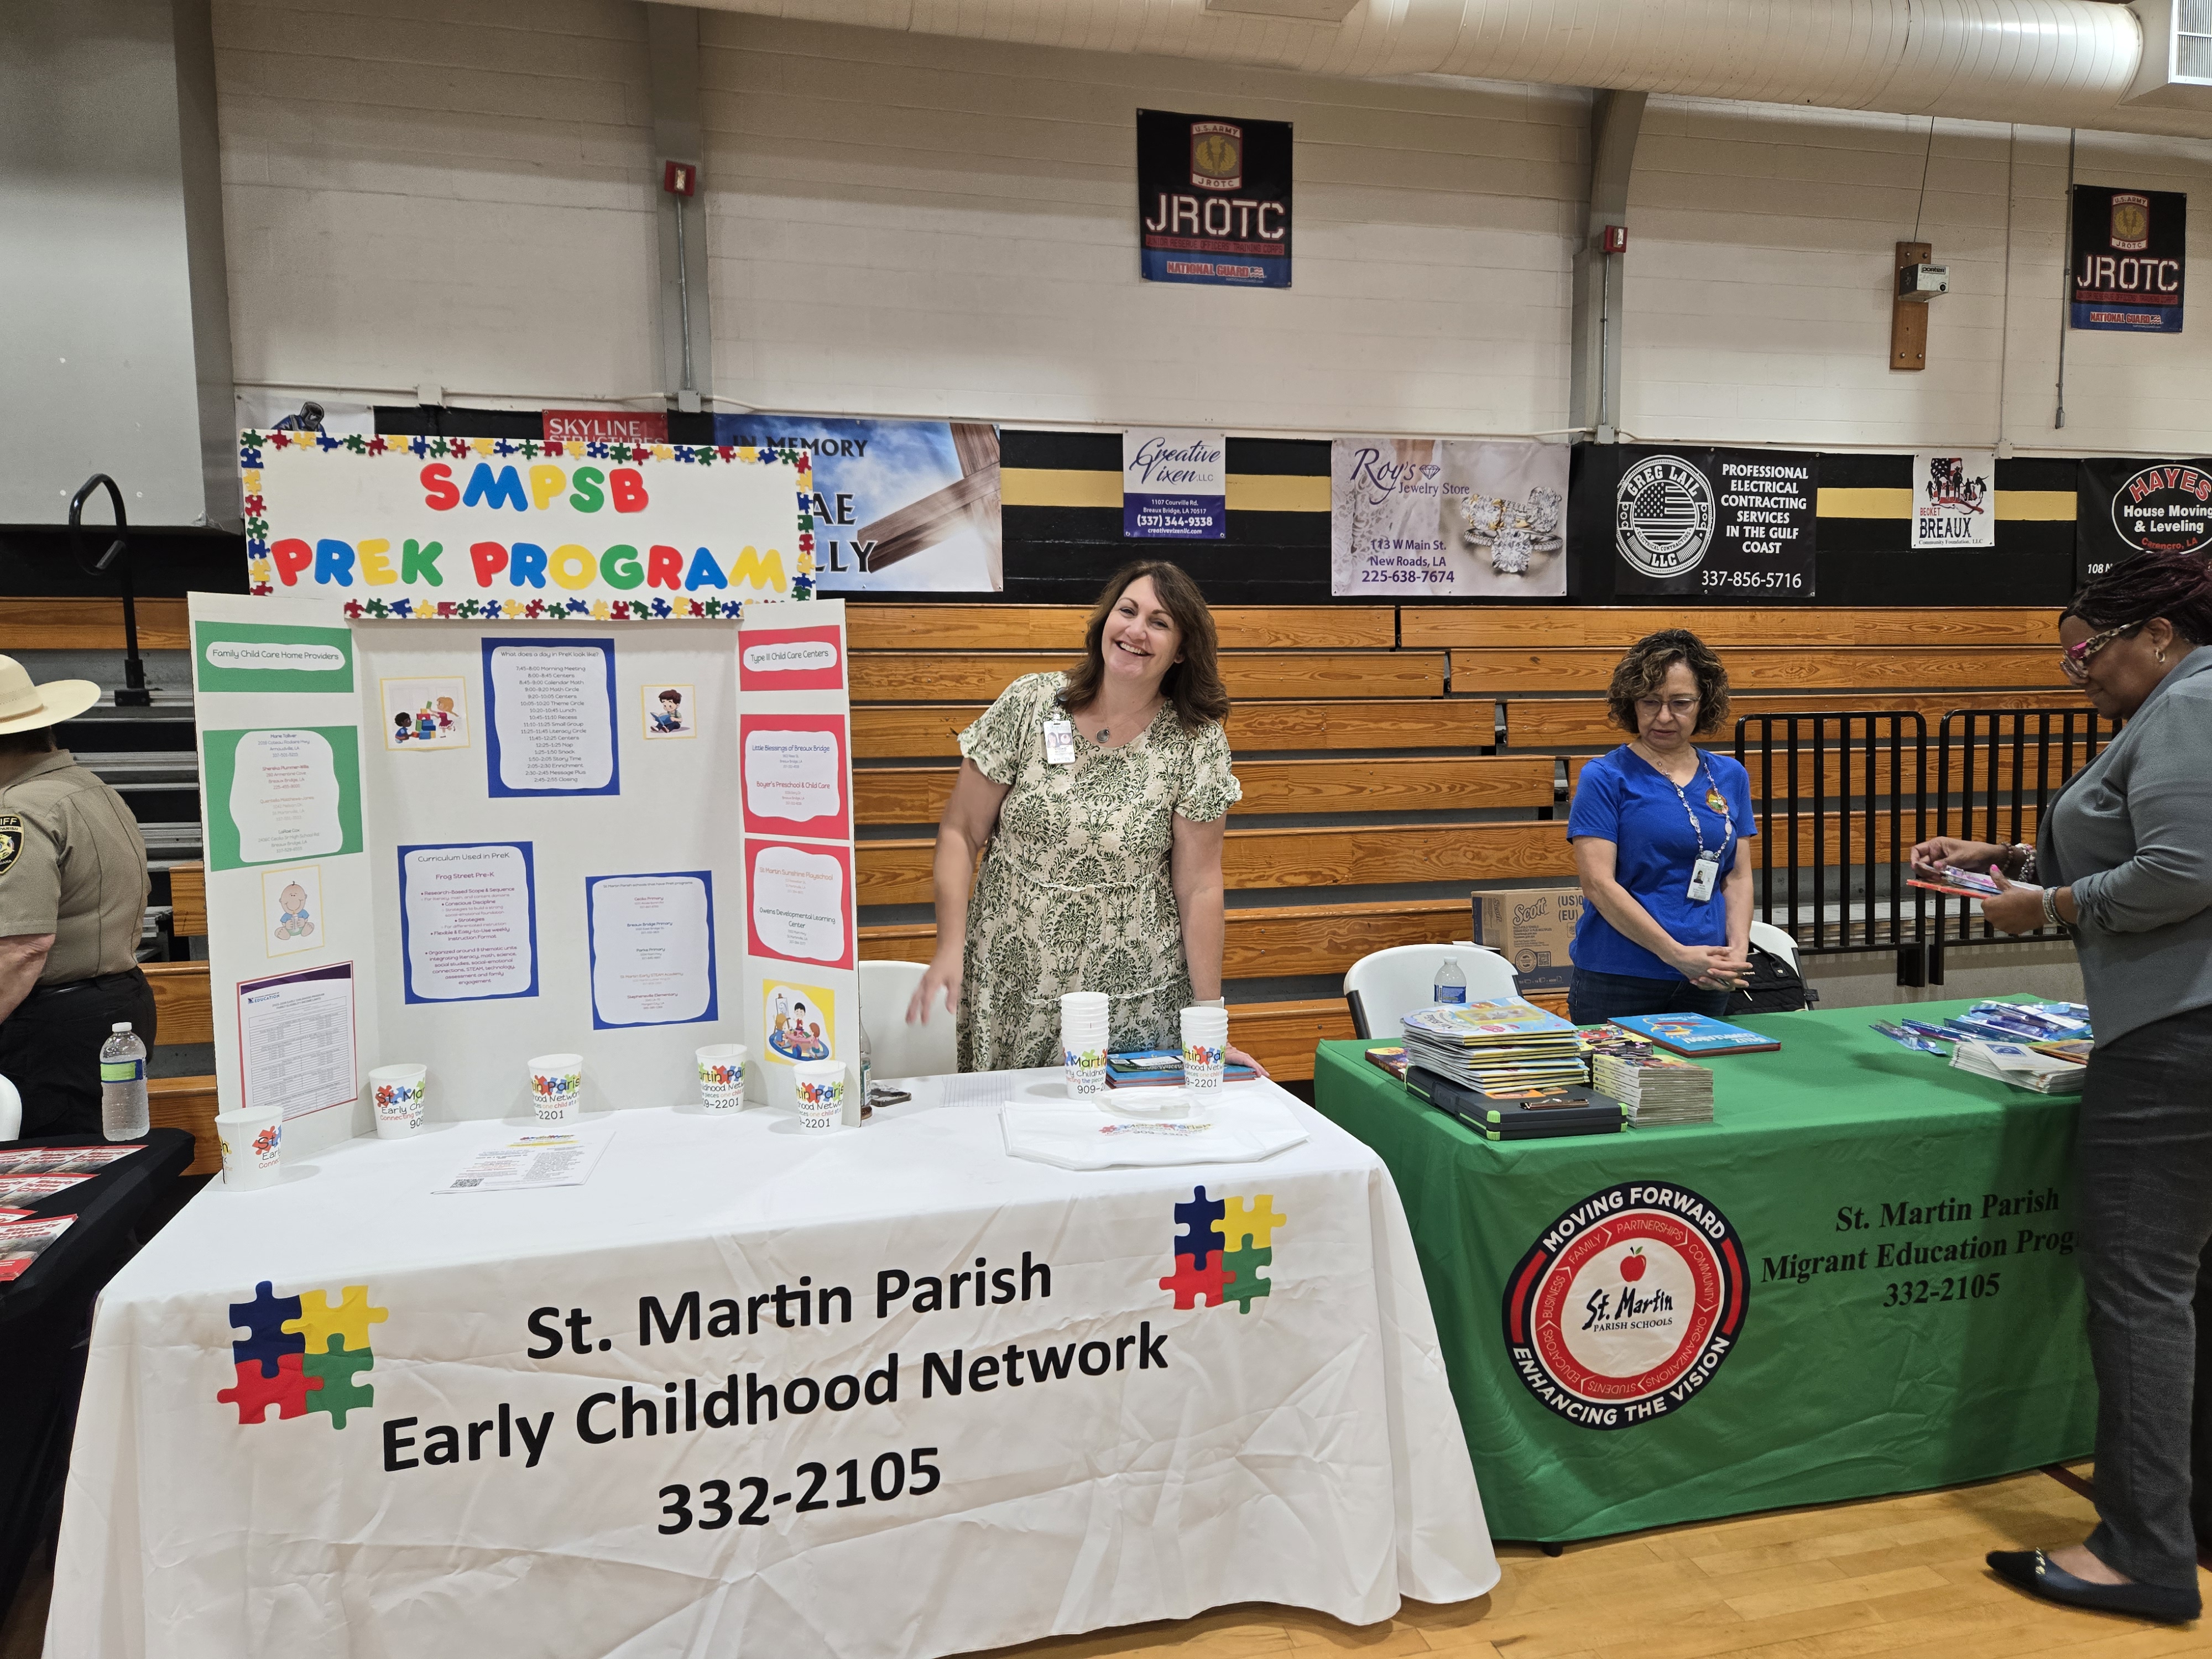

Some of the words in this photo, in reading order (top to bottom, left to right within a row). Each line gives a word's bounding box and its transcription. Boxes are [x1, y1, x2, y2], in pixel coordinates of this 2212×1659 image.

[1212, 125, 1238, 135] ARMY
[1198, 178, 1234, 187] JROTC
[1145, 193, 1285, 240] JROTC
[1167, 261, 1215, 275] NATIONAL
[1217, 264, 1250, 278] GUARD
[2077, 254, 2179, 291] JROTC
[2090, 312, 2125, 323] NATIONAL
[2126, 314, 2151, 324] GUARD
[549, 419, 639, 435] SKYLINE
[766, 435, 868, 457] MEMORY
[1136, 437, 1220, 466] Creative
[1350, 448, 1415, 505] Roy's
[1722, 464, 1809, 479] PROFESSIONAL
[420, 462, 649, 513] SMPSB
[1627, 466, 1663, 497] GREG
[1669, 466, 1699, 497] LAIL
[1730, 480, 1799, 494] ELECTRICAL
[2128, 468, 2211, 503] HAYES
[1398, 482, 1438, 499] Jewelry
[1443, 483, 1470, 494] Store
[1721, 495, 1807, 509] CONTRACTING
[1737, 511, 1790, 524] SERVICES
[2124, 505, 2164, 517] House
[1137, 514, 1162, 526] (337)
[1165, 517, 1213, 526] 344-9338
[1919, 518, 1971, 538] BREAUX
[2135, 520, 2146, 532] &
[2150, 520, 2204, 534] Leveling
[1636, 531, 1660, 551] ELECTRICAL
[1661, 531, 1691, 551] CONTRACTORS
[1726, 526, 1739, 537] IN
[1743, 526, 1766, 538] THE
[1770, 527, 1799, 539] GULF
[1371, 540, 1391, 550] 113
[1392, 540, 1404, 550] W
[1405, 540, 1431, 550] Main
[1433, 540, 1447, 550] St.
[1743, 541, 1782, 554] COAST
[2186, 537, 2198, 547] LA
[272, 538, 443, 588] PREK
[470, 544, 787, 593] PROGRAM
[1370, 556, 1395, 566] New
[1396, 556, 1431, 568] Roads,
[1433, 556, 1446, 566] LA
[1651, 553, 1677, 567] LLC
[2088, 564, 2104, 573] 108
[1361, 570, 1454, 582] 225-638-7674
[1702, 571, 1802, 588] 337-856-5716
[213, 649, 239, 659] Family
[751, 653, 765, 664] Type
[771, 652, 786, 660] Child
[803, 650, 829, 659] Centers
[1512, 897, 1547, 926] Scott
[1558, 910, 1578, 922] (EU)
[254, 994, 280, 1003] EDUCATION
[378, 1092, 397, 1104] St.
[382, 1106, 406, 1114] Early
[1836, 1206, 1870, 1232] St.
[1879, 1197, 1972, 1228] Martin
[1980, 1187, 2059, 1219] Parish
[1542, 1191, 1624, 1253] MOVING
[1630, 1187, 1726, 1239] FORWARD
[1568, 1234, 1601, 1264] FAMILY
[1616, 1220, 1683, 1241] PARTNERSHIPS
[1688, 1244, 1714, 1302] COMMUNITY
[1761, 1248, 1869, 1285] Migrant
[1875, 1237, 2007, 1269] Education
[1542, 1276, 1566, 1317] BUSINESS
[1883, 1272, 2001, 1308] 332-2105
[527, 1303, 612, 1360] St.
[637, 1274, 854, 1347] Martin
[875, 1250, 1051, 1319] Parish
[1582, 1288, 1610, 1330] St.
[1615, 1286, 1673, 1319] Martin
[1594, 1322, 1628, 1332] PARISH
[1630, 1317, 1673, 1329] SCHOOLS
[1545, 1329, 1580, 1383] EDUCATORS
[1646, 1317, 1707, 1387] ORGANIZATIONS
[1513, 1347, 1617, 1425] ENHANCING
[1625, 1398, 1667, 1421] THE
[1670, 1337, 1730, 1401] VISION
[1588, 1380, 1636, 1394] STUDENTS
[383, 1404, 555, 1472] Early
[576, 1352, 900, 1446] Childhood
[921, 1320, 1168, 1397] Network
[658, 1447, 942, 1536] 332-2105
